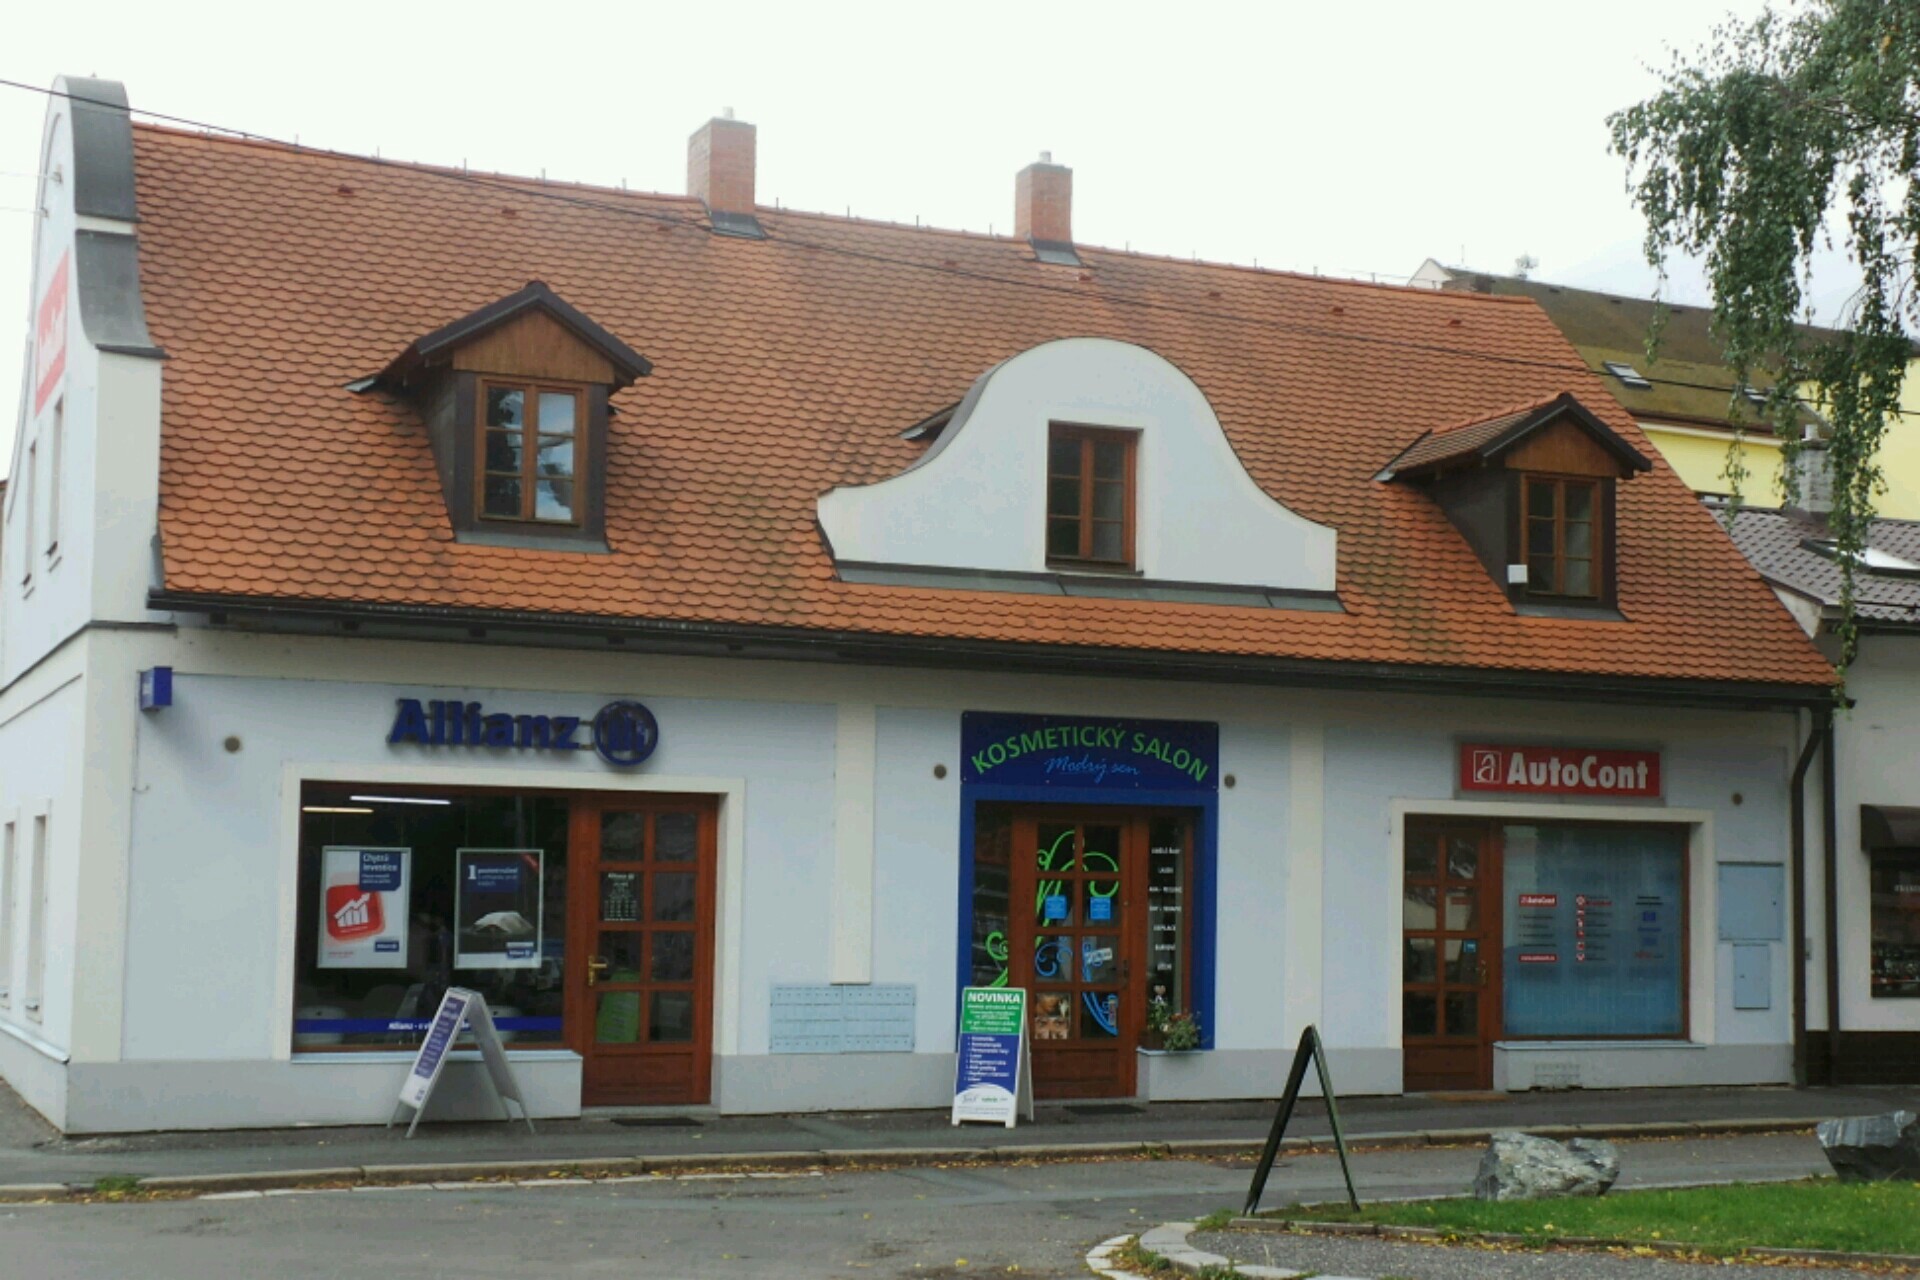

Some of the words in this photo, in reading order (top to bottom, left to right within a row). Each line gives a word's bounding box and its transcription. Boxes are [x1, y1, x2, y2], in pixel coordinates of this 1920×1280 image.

[387, 698, 580, 750] Allianz
[971, 722, 1126, 774] KOSMETICKÝ
[1131, 732, 1209, 782] SALON
[1506, 752, 1649, 790] AutoCont
[468, 865, 477, 880] 1
[967, 991, 1021, 1004] NOVINKA
